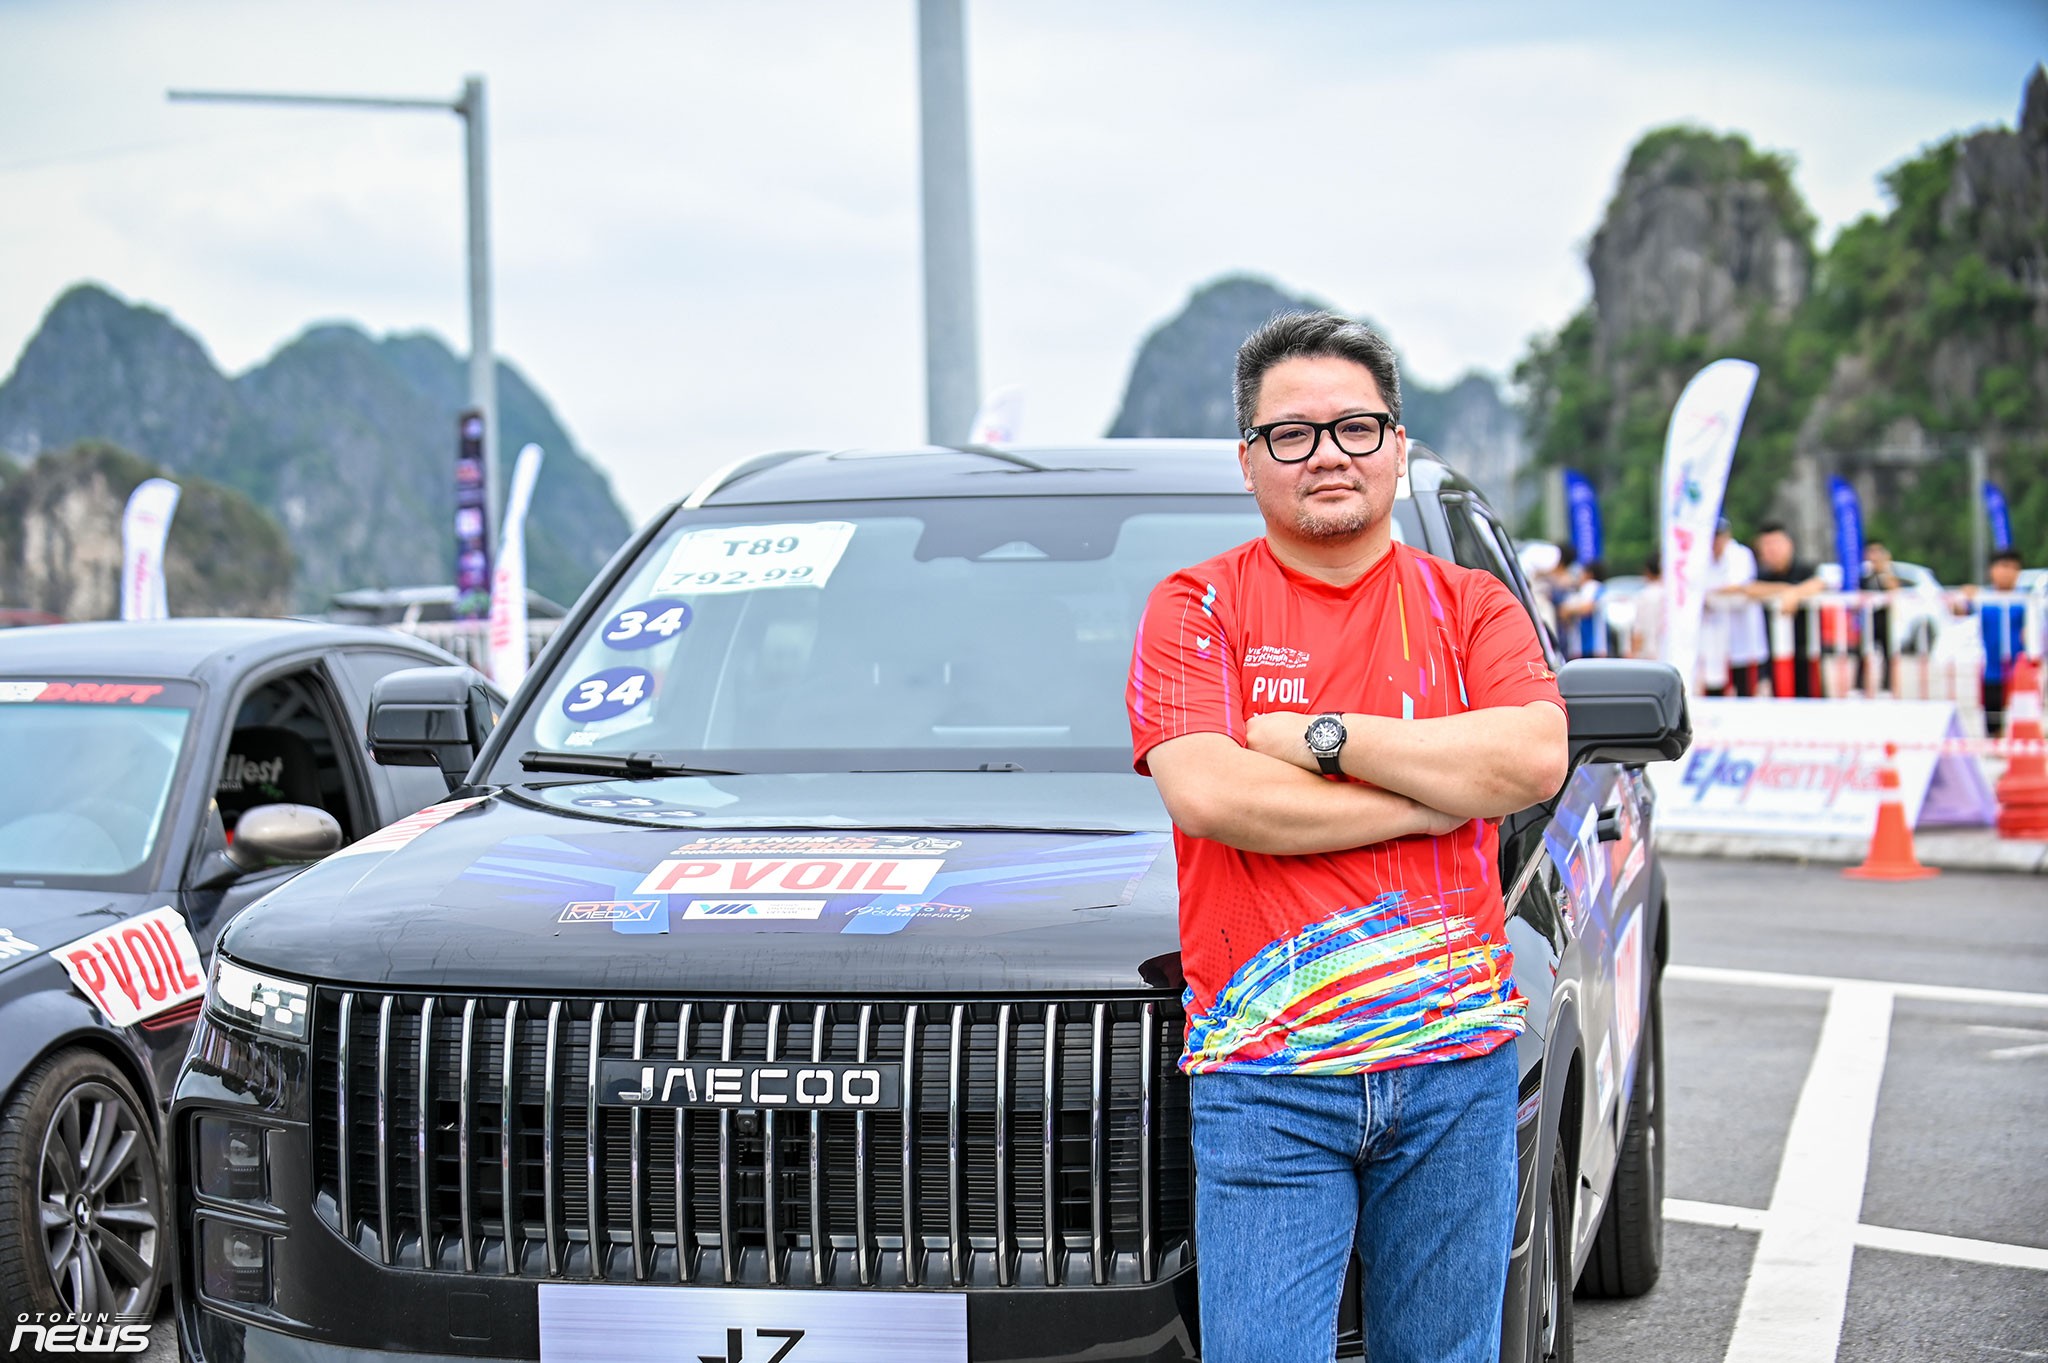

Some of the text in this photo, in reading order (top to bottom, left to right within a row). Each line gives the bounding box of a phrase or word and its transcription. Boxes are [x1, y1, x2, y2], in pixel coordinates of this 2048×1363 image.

[723, 536, 799, 557] T89
[671, 565, 814, 586] 792.99
[607, 607, 685, 641] 34
[35, 682, 165, 703] DRIFT
[568, 674, 645, 713] 34
[1252, 676, 1309, 704] PVOIL
[656, 861, 908, 891] PVOIL
[566, 910, 645, 920] MEDIA
[66, 918, 200, 1021] PVOIL
[618, 1066, 881, 1105] JAECOO
[697, 1327, 806, 1363] J7
